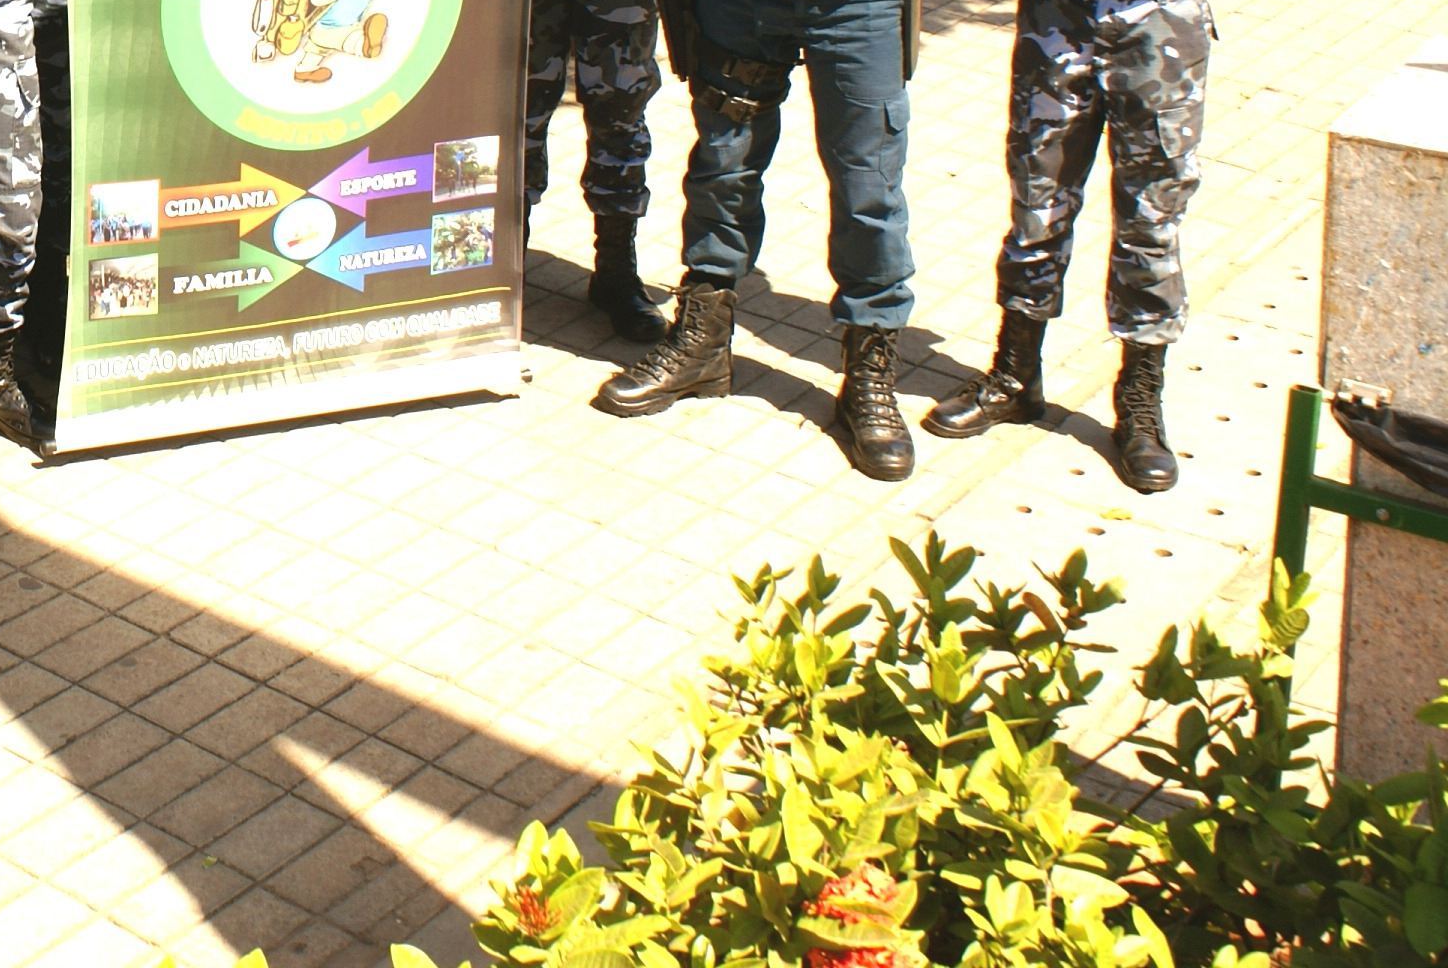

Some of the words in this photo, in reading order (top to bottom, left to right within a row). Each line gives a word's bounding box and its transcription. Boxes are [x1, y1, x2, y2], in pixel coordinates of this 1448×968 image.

[339, 170, 416, 197] ESPORTE
[164, 189, 278, 218] CIDADANIA
[339, 244, 427, 272] NATUREZA
[75, 347, 175, 384] EDUCAÇÃO
[294, 323, 364, 354] FUTURO
[364, 316, 405, 344] COM
[407, 302, 501, 338] QUALIDADE
